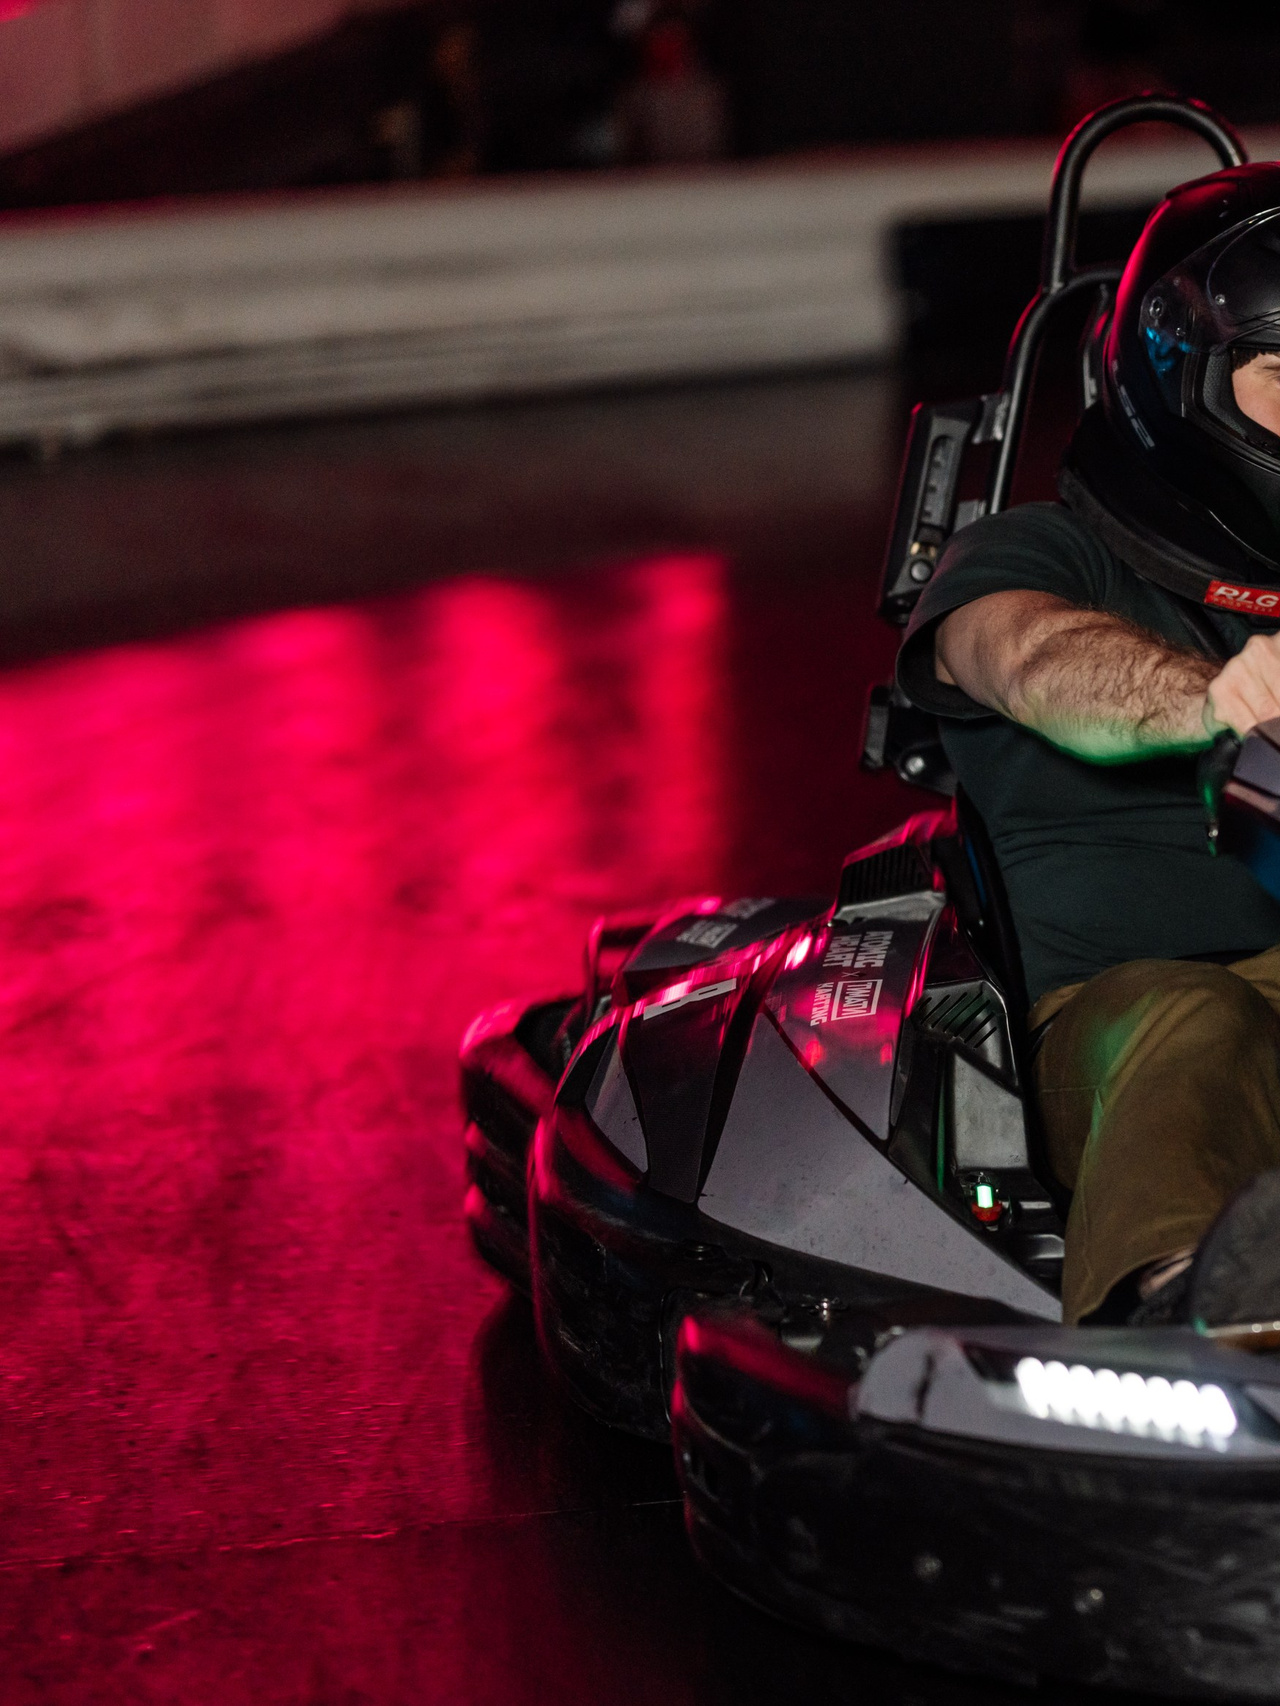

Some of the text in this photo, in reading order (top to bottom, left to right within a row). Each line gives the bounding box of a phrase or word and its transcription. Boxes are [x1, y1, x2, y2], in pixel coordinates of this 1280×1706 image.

[1213, 586, 1279, 608] RLG
[822, 934, 862, 967] HEART
[853, 931, 894, 968] ATOMIC
[810, 982, 835, 1027] KARTING
